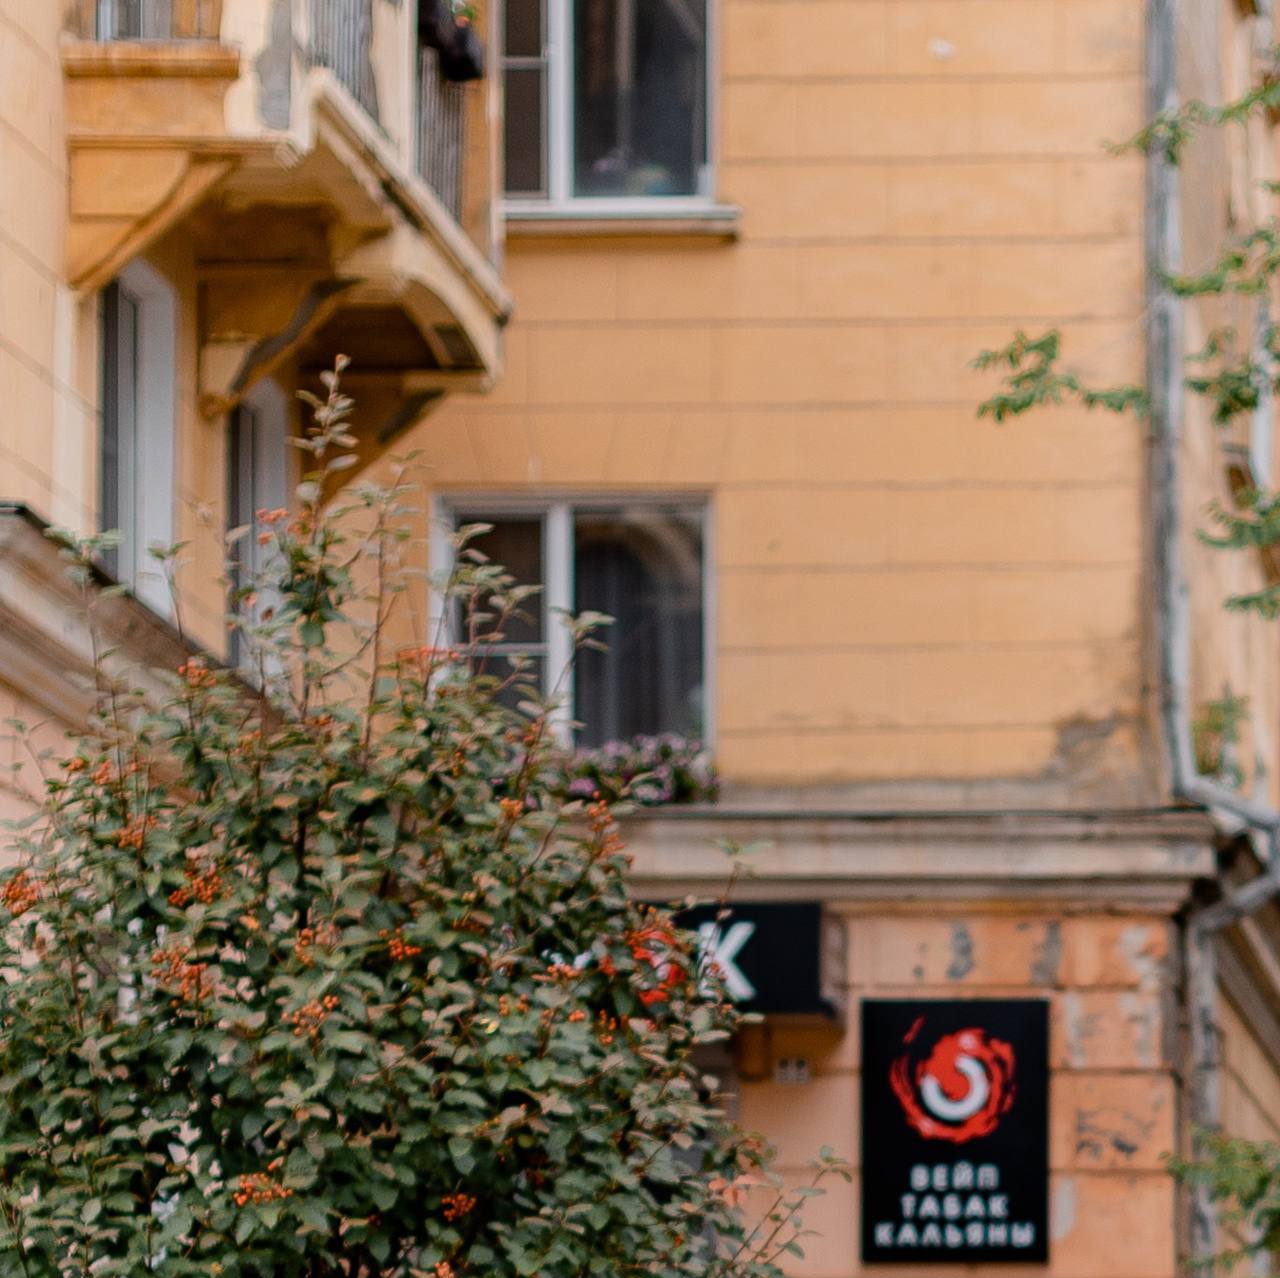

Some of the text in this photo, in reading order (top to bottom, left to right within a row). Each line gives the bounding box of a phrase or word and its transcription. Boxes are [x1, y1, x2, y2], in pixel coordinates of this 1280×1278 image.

[911, 1160, 999, 1191] ВЕЙП
[901, 1194, 1009, 1219] ТАБАК
[875, 1222, 1035, 1248] КАЛЬЯНЫ
